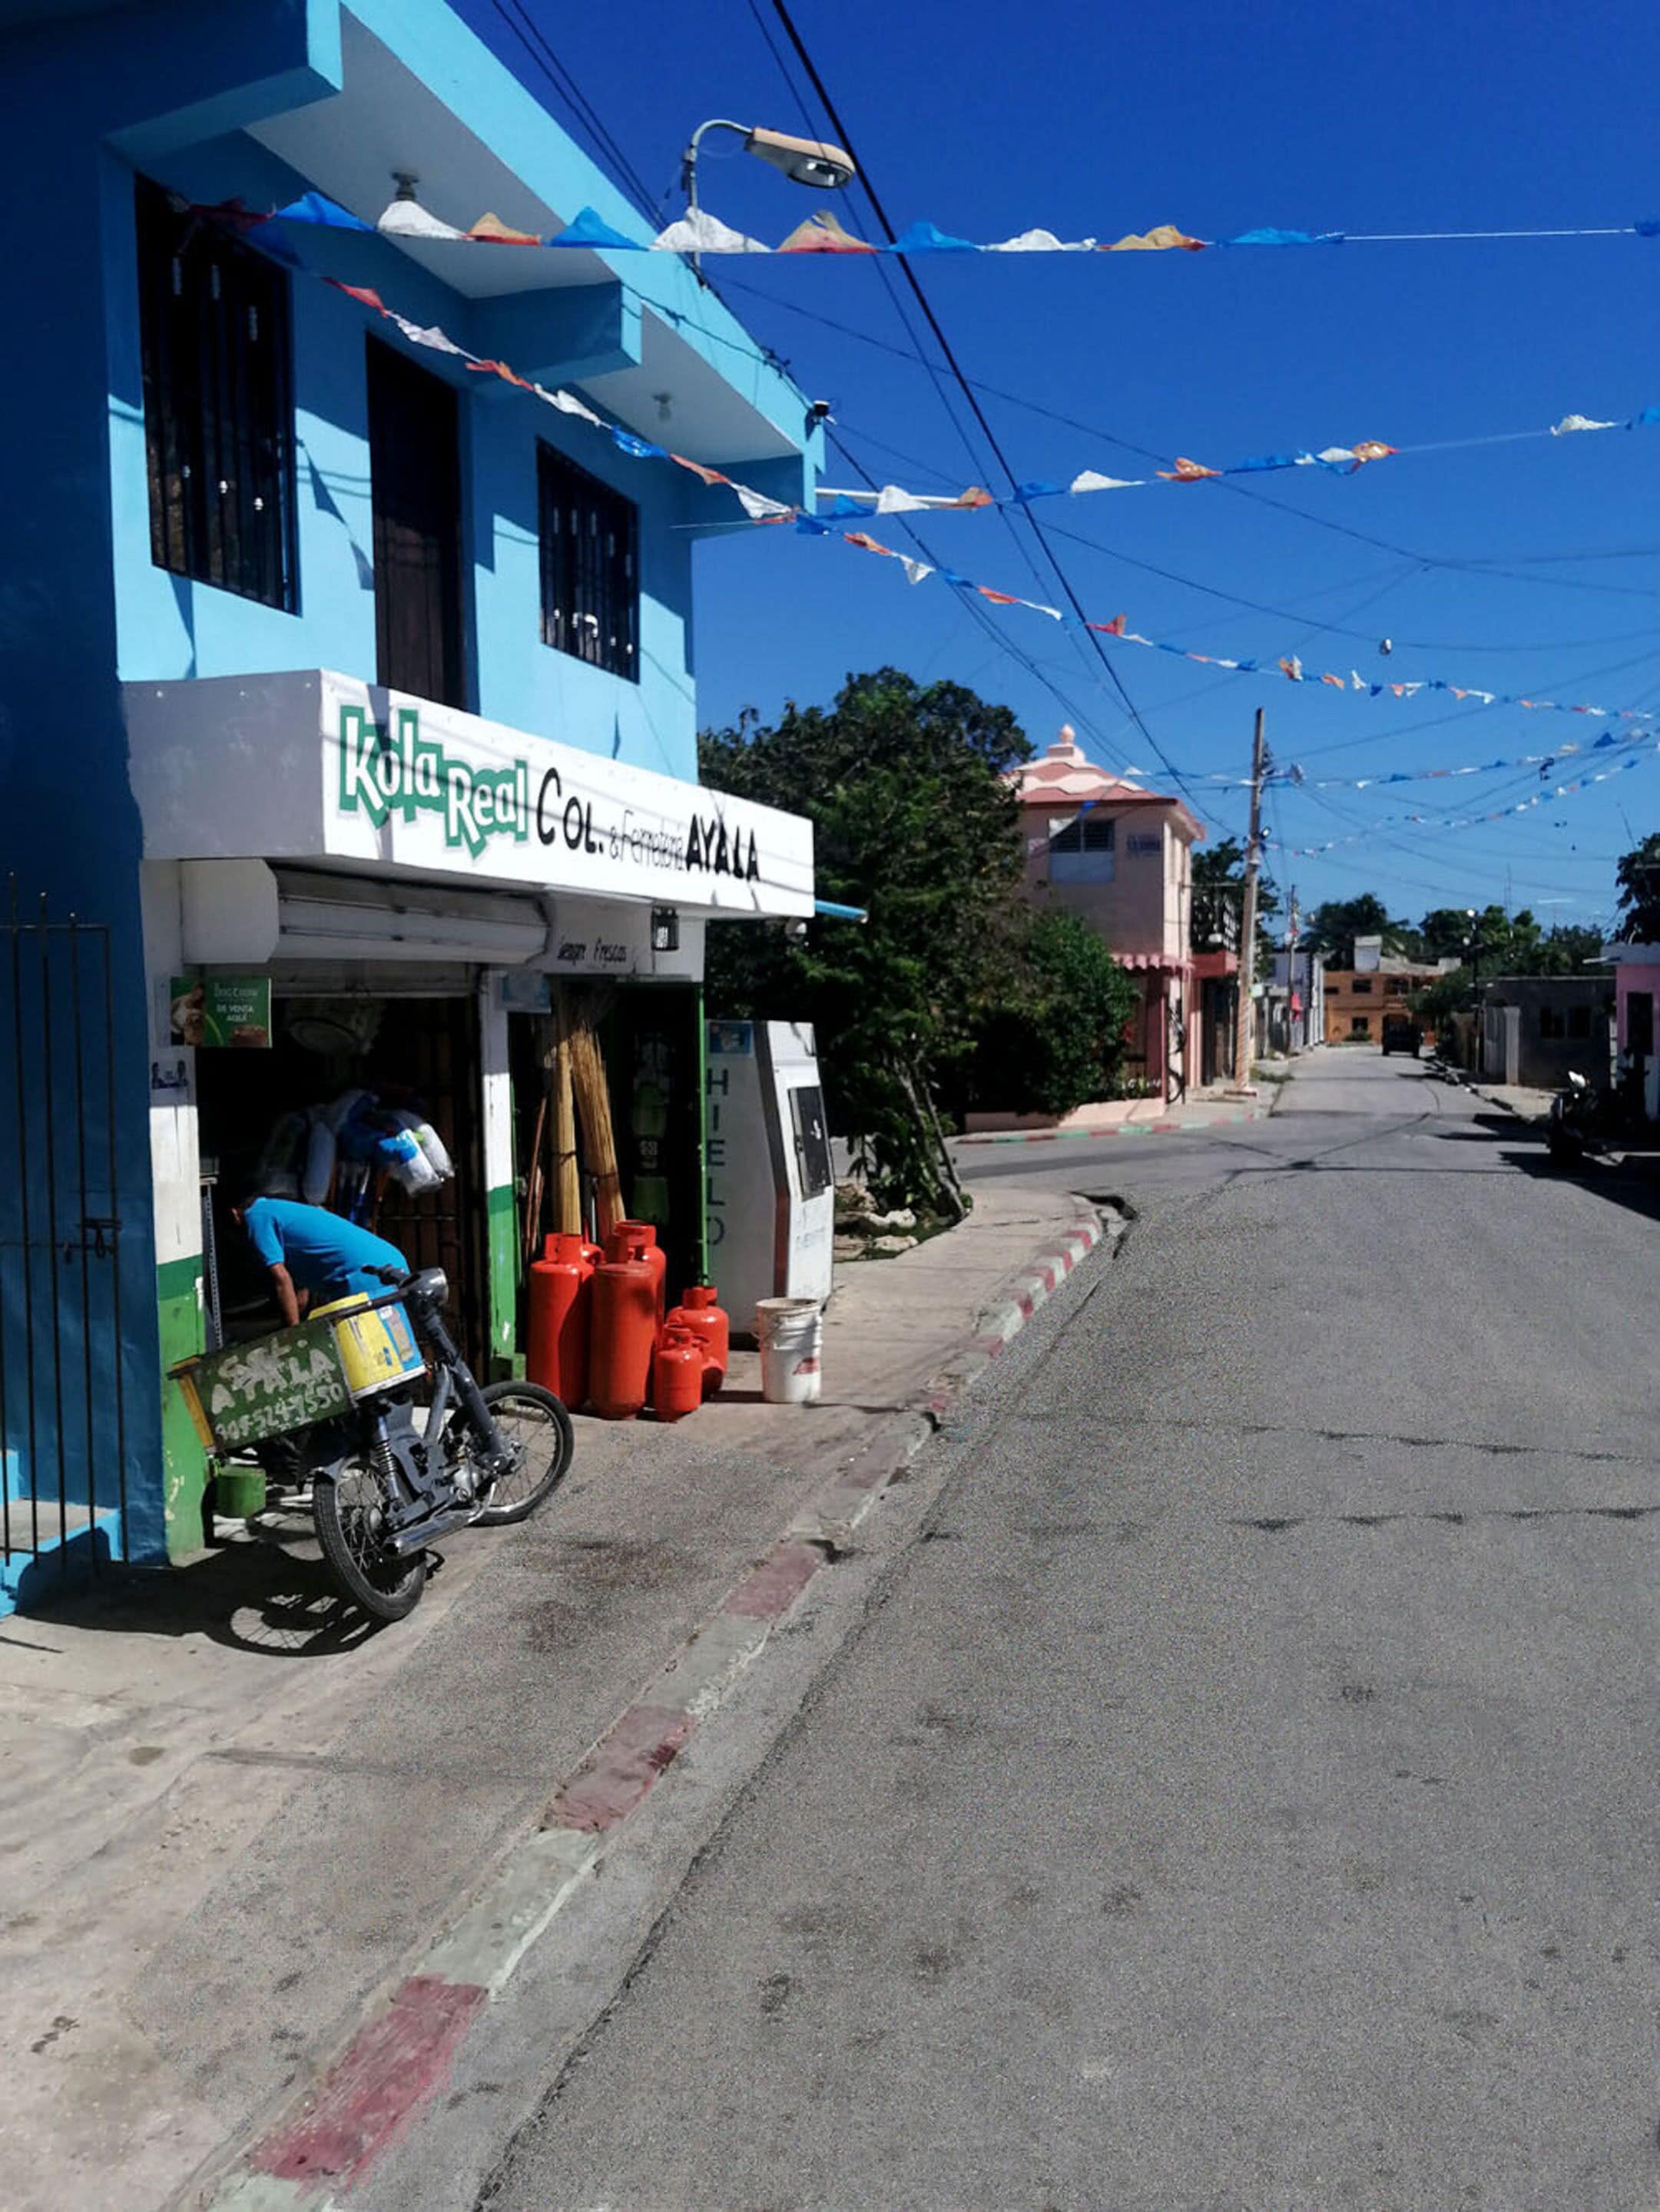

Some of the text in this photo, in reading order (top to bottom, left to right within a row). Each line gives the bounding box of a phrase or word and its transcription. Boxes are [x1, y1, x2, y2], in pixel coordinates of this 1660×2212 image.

[340, 707, 443, 824] Kola
[445, 760, 528, 855] Real
[685, 813, 760, 882] AYALA
[228, 1005, 254, 1014] VENTA
[706, 1068, 729, 1247] HIELO
[211, 1348, 336, 1416] AYALA
